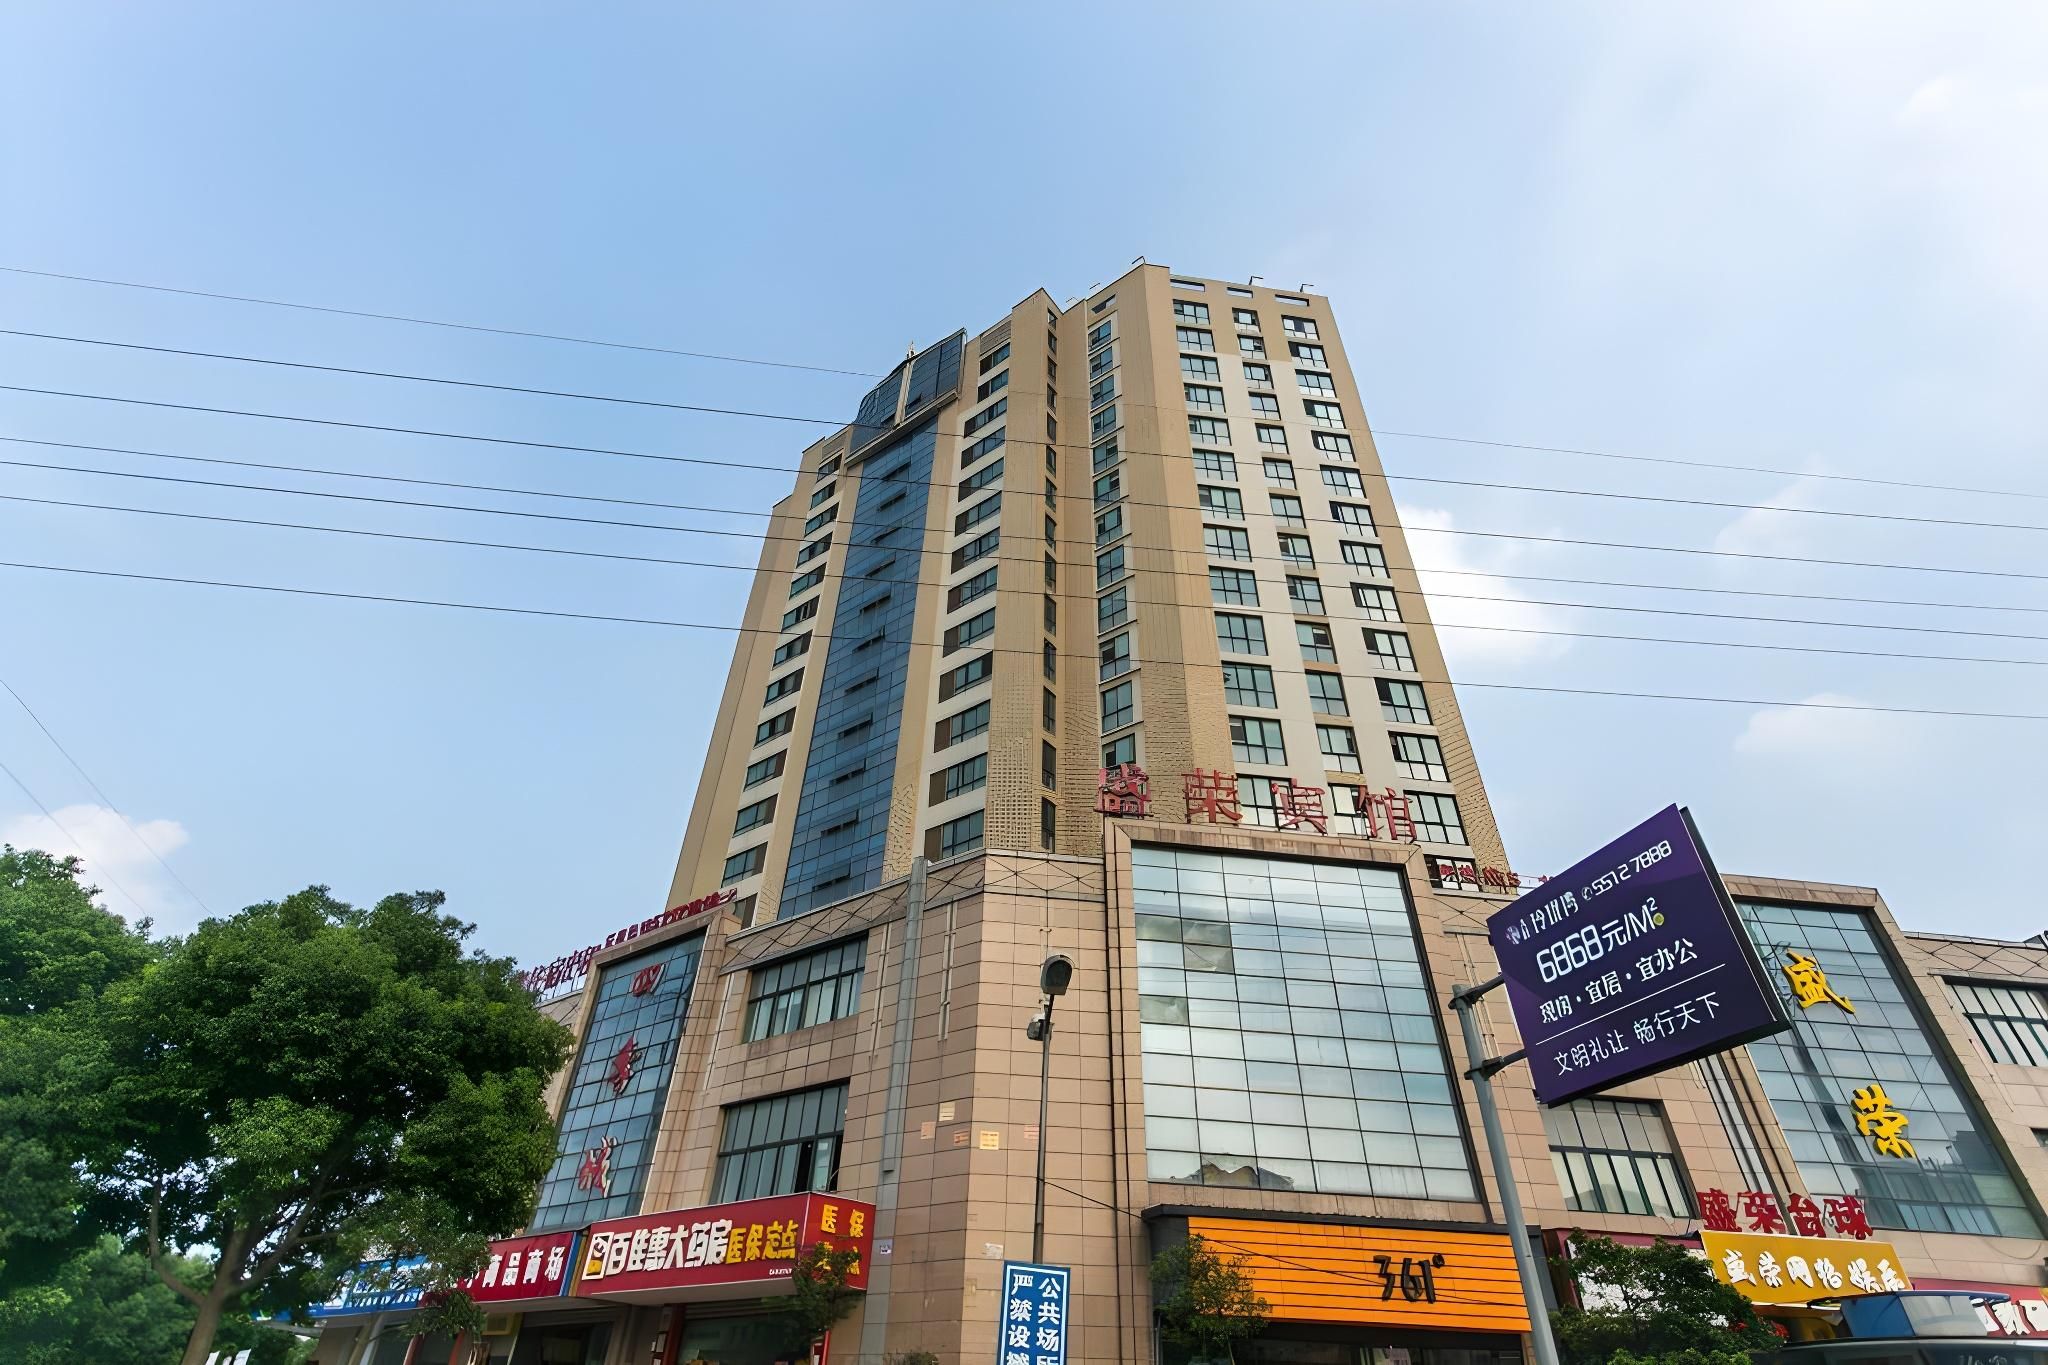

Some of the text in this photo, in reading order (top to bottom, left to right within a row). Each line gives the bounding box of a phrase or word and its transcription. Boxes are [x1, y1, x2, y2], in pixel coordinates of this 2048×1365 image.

[1554, 991, 1720, 1076] 文明礼让 畅行天下
[726, 1219, 799, 1265] 医保定点
[821, 1203, 865, 1238] 医保
